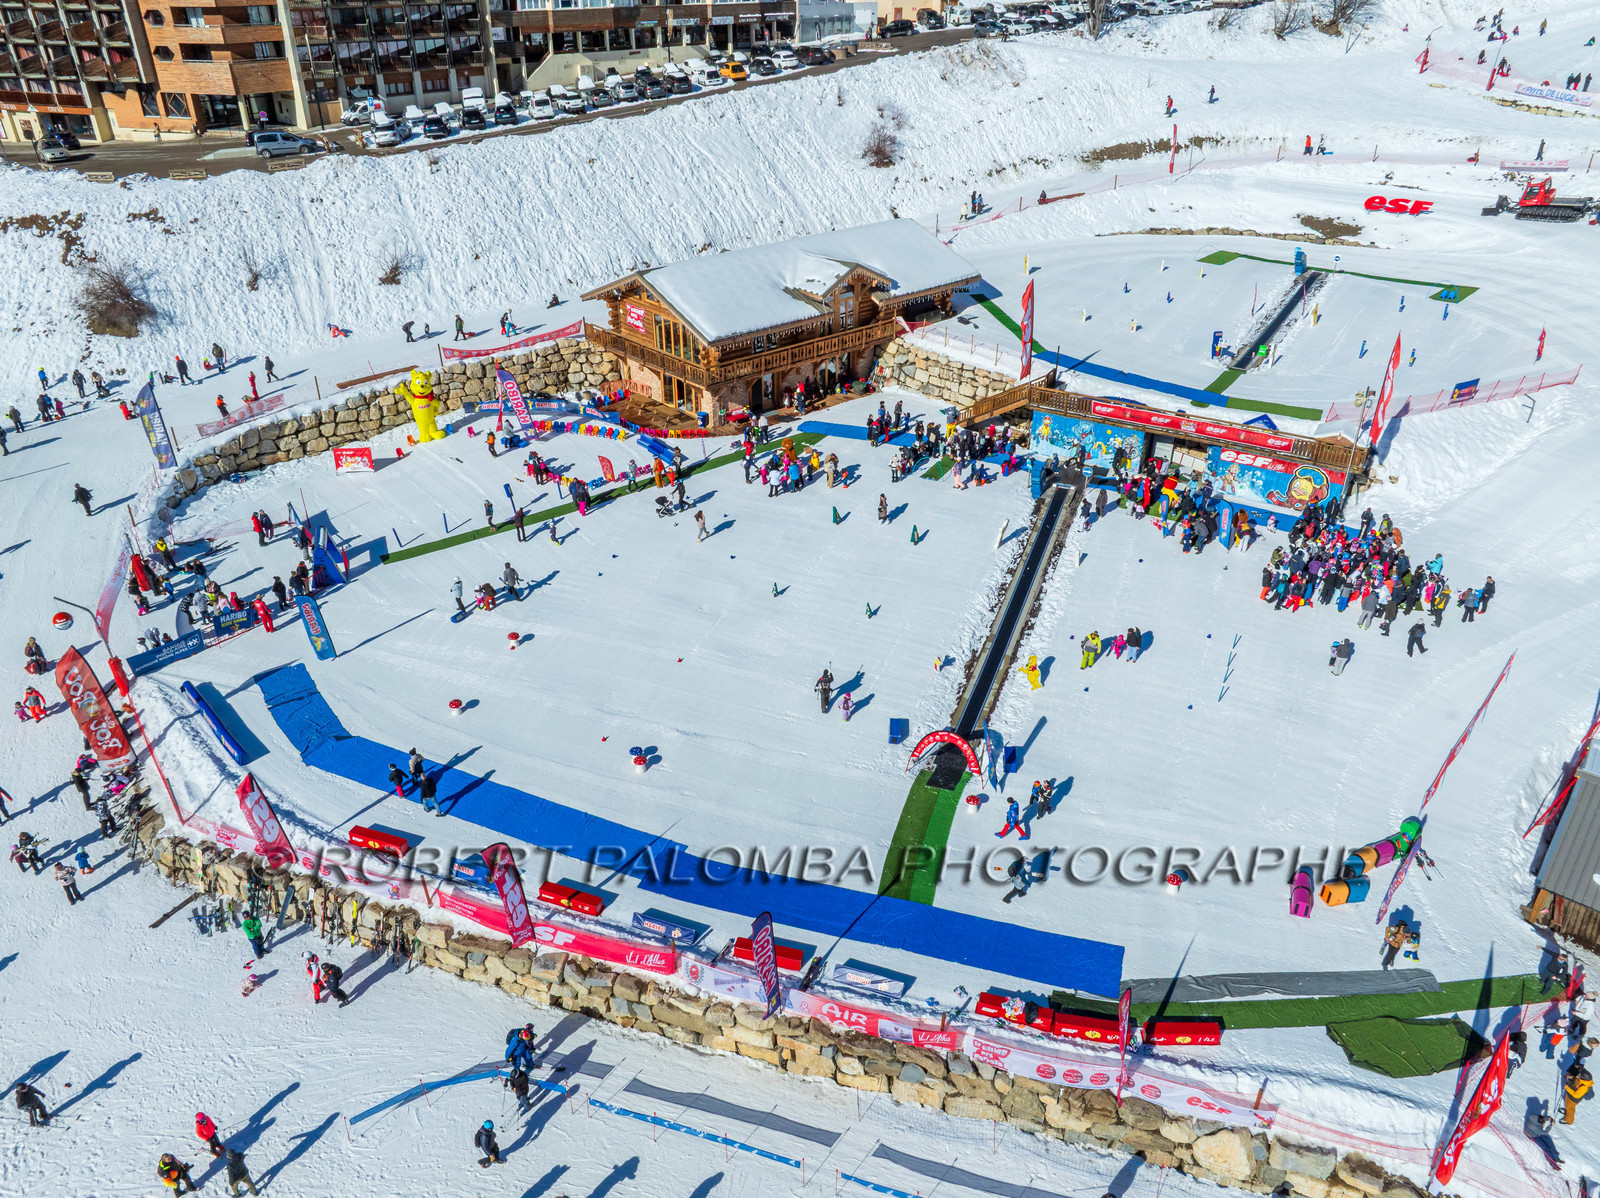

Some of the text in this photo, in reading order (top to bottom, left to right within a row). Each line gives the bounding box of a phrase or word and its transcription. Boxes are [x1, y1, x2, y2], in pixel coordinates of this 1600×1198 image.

[1545, 89, 1555, 98] DE
[1555, 91, 1577, 102] LUGE
[220, 610, 247, 623] HARIBO
[156, 645, 187, 659] POPULAIRE
[162, 640, 186, 653] BANQUE
[174, 647, 188, 655] ALPES
[453, 863, 475, 877] HARIBO
[644, 920, 666, 933] HARIBO
[847, 972, 871, 985] HARIBO
[822, 1003, 868, 1025] AIR
